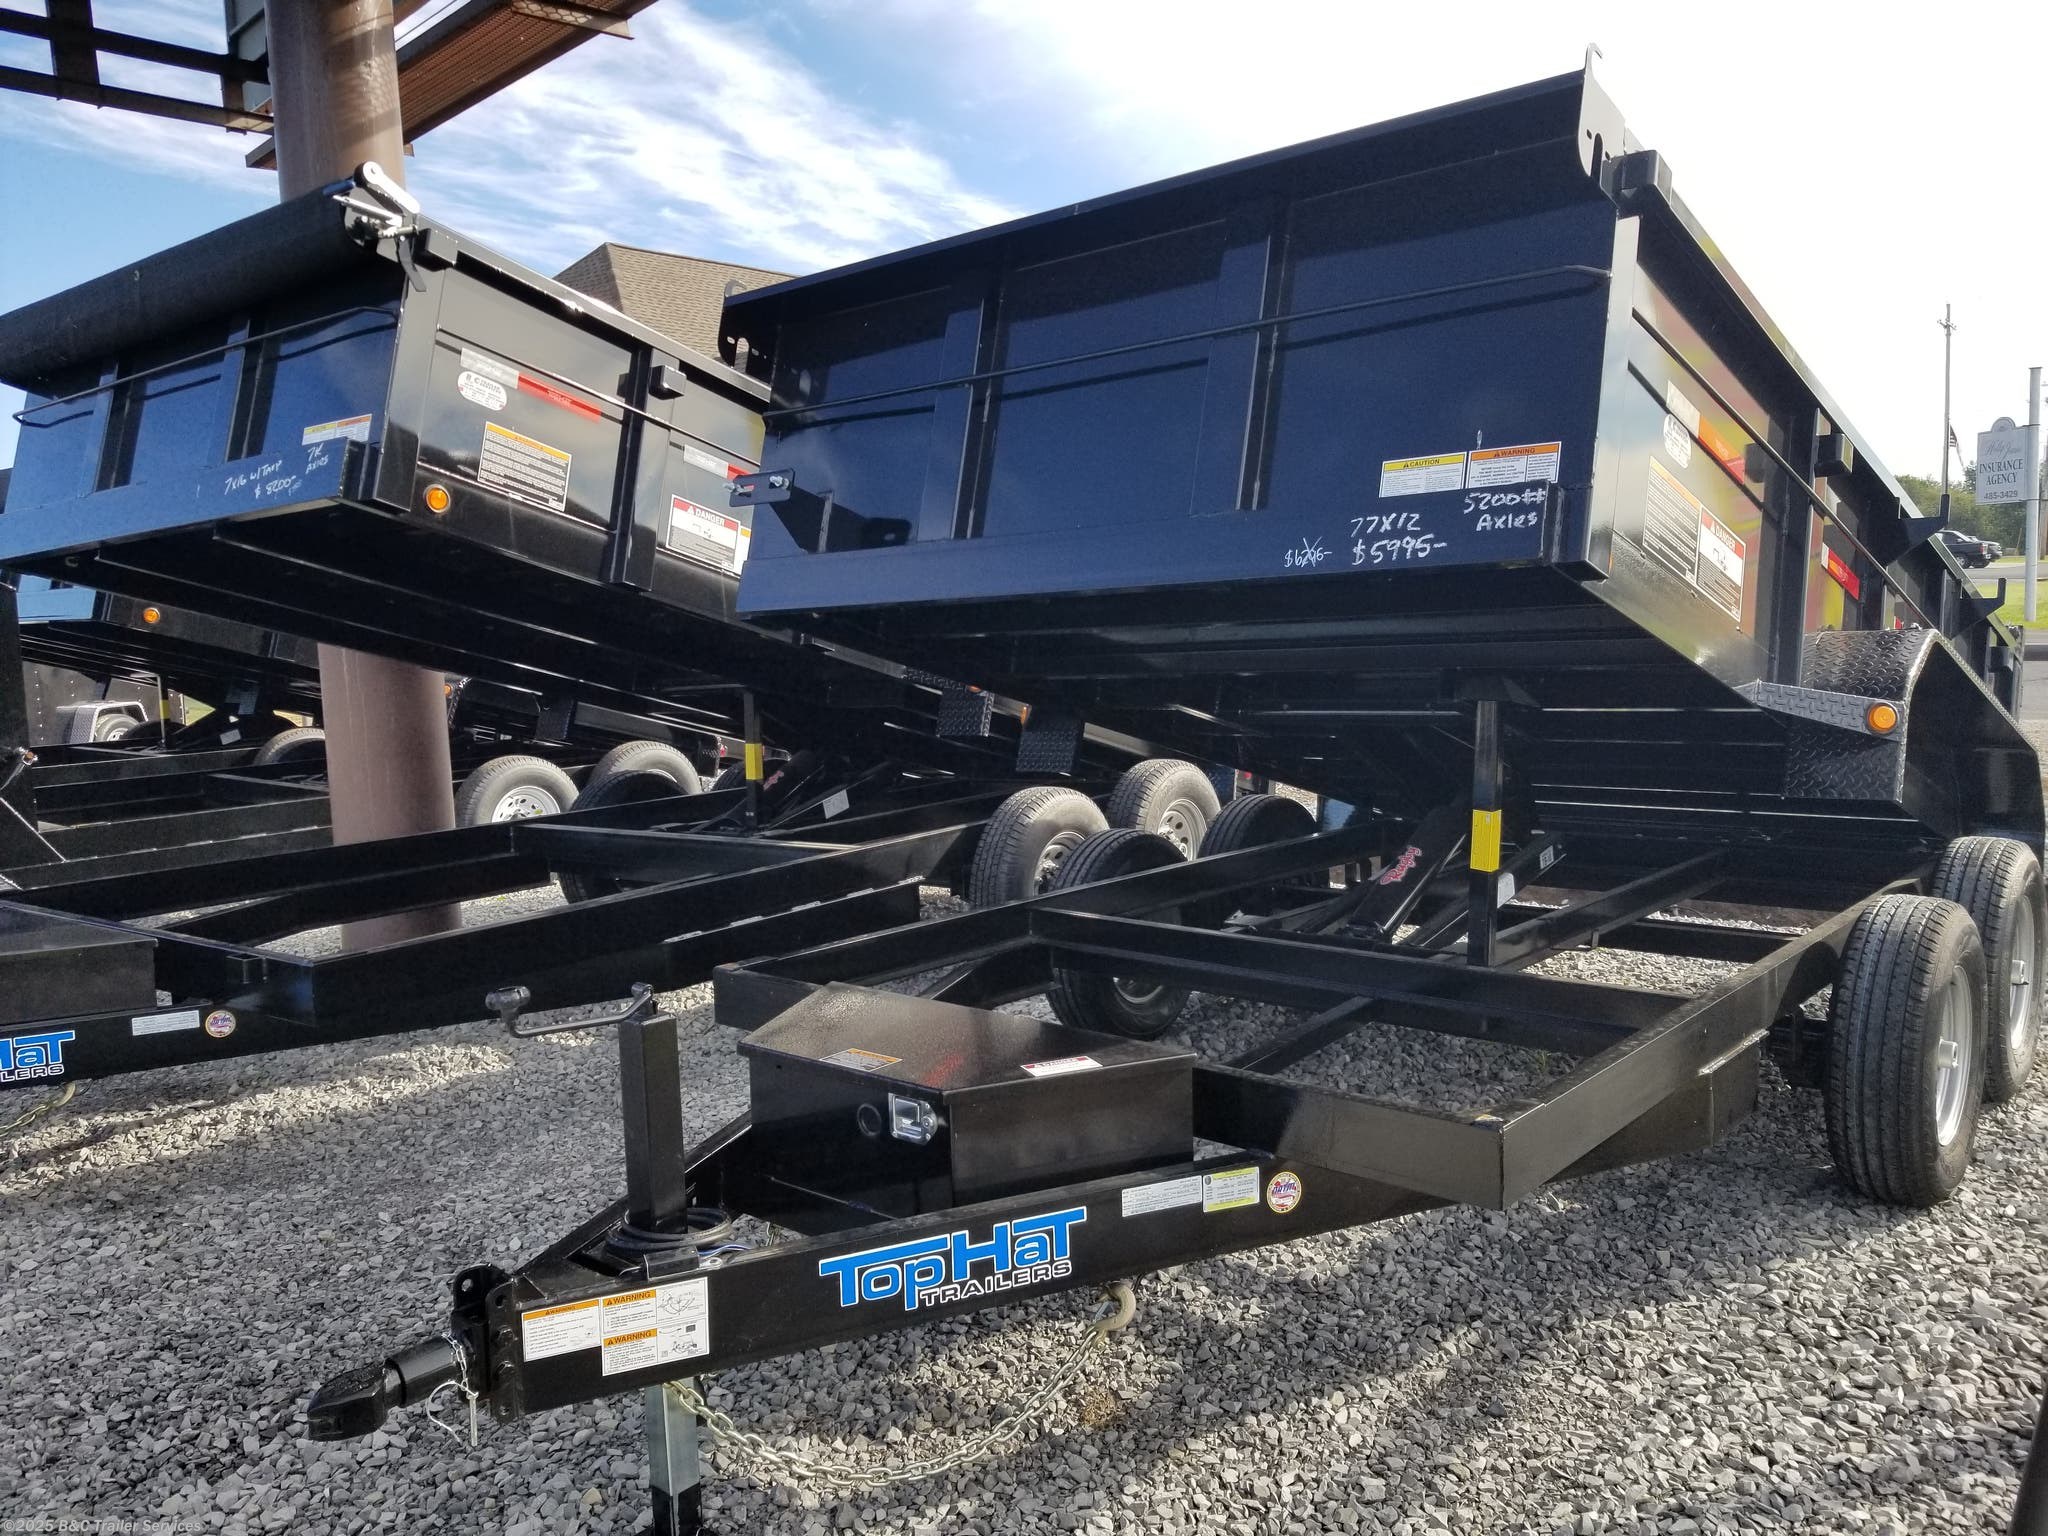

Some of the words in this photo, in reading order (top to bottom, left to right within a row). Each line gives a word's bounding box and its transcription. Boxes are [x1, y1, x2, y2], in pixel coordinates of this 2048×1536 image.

[1501, 447, 1536, 457] WARNING
[1409, 458, 1440, 468] CAUTION
[1979, 459, 2024, 474] INSURANCE
[1986, 472, 2017, 486] AGENCY
[919, 1259, 1072, 1307] TRAILERS
[613, 1290, 651, 1305] WARNING
[614, 1329, 652, 1344] WARNING
